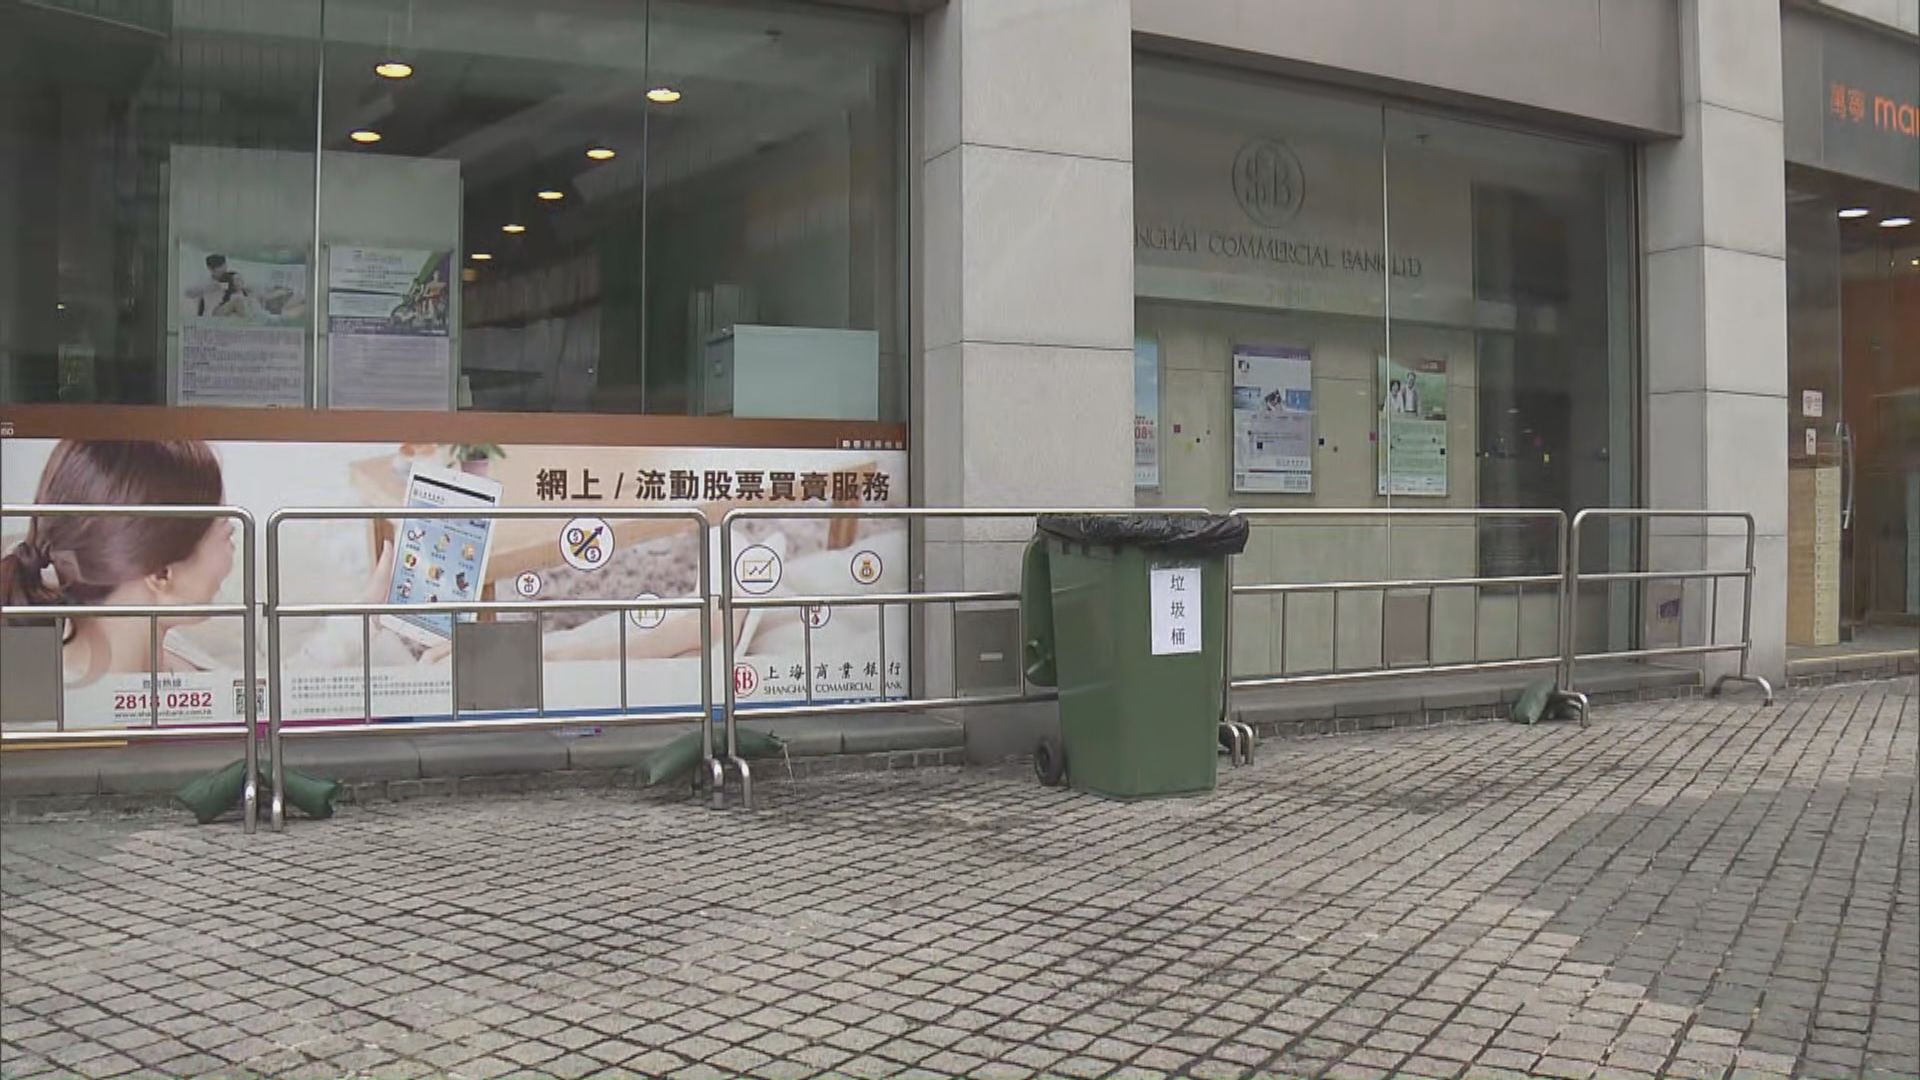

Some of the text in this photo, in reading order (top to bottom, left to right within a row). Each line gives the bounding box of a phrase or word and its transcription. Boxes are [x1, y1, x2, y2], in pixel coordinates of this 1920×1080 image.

[1208, 231, 1336, 269] COMMERCIAL
[536, 468, 602, 501] 網上
[635, 469, 890, 502] 流動股票買賣服務
[1170, 574, 1185, 645] 垃圾桶
[166, 692, 212, 708] 0282
[763, 680, 903, 695] SHANGHA COMMERCIAL ANK
